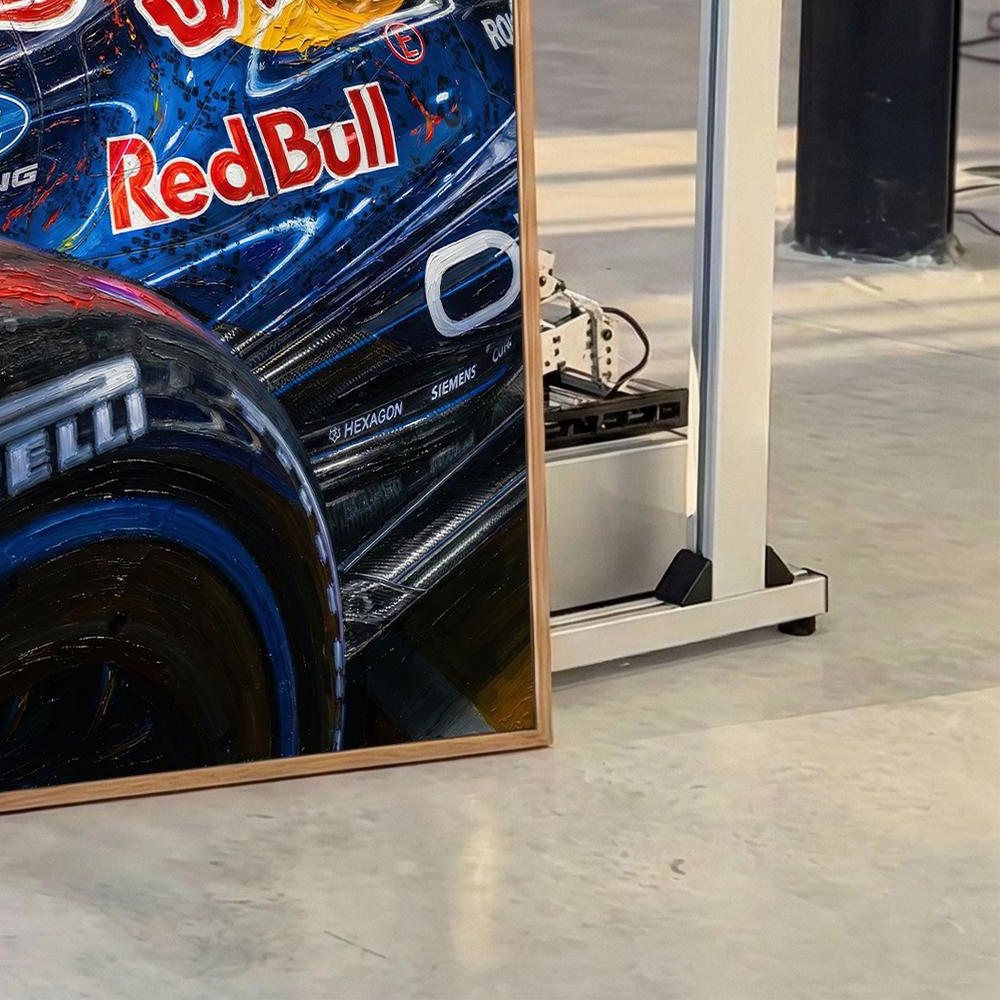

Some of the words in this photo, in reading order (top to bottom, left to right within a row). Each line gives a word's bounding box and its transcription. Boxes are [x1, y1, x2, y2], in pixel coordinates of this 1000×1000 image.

[106, 114, 269, 235] Red
[253, 81, 399, 194] Bull
[431, 364, 477, 401] SIEMENS
[343, 401, 404, 438] HEXAGON
